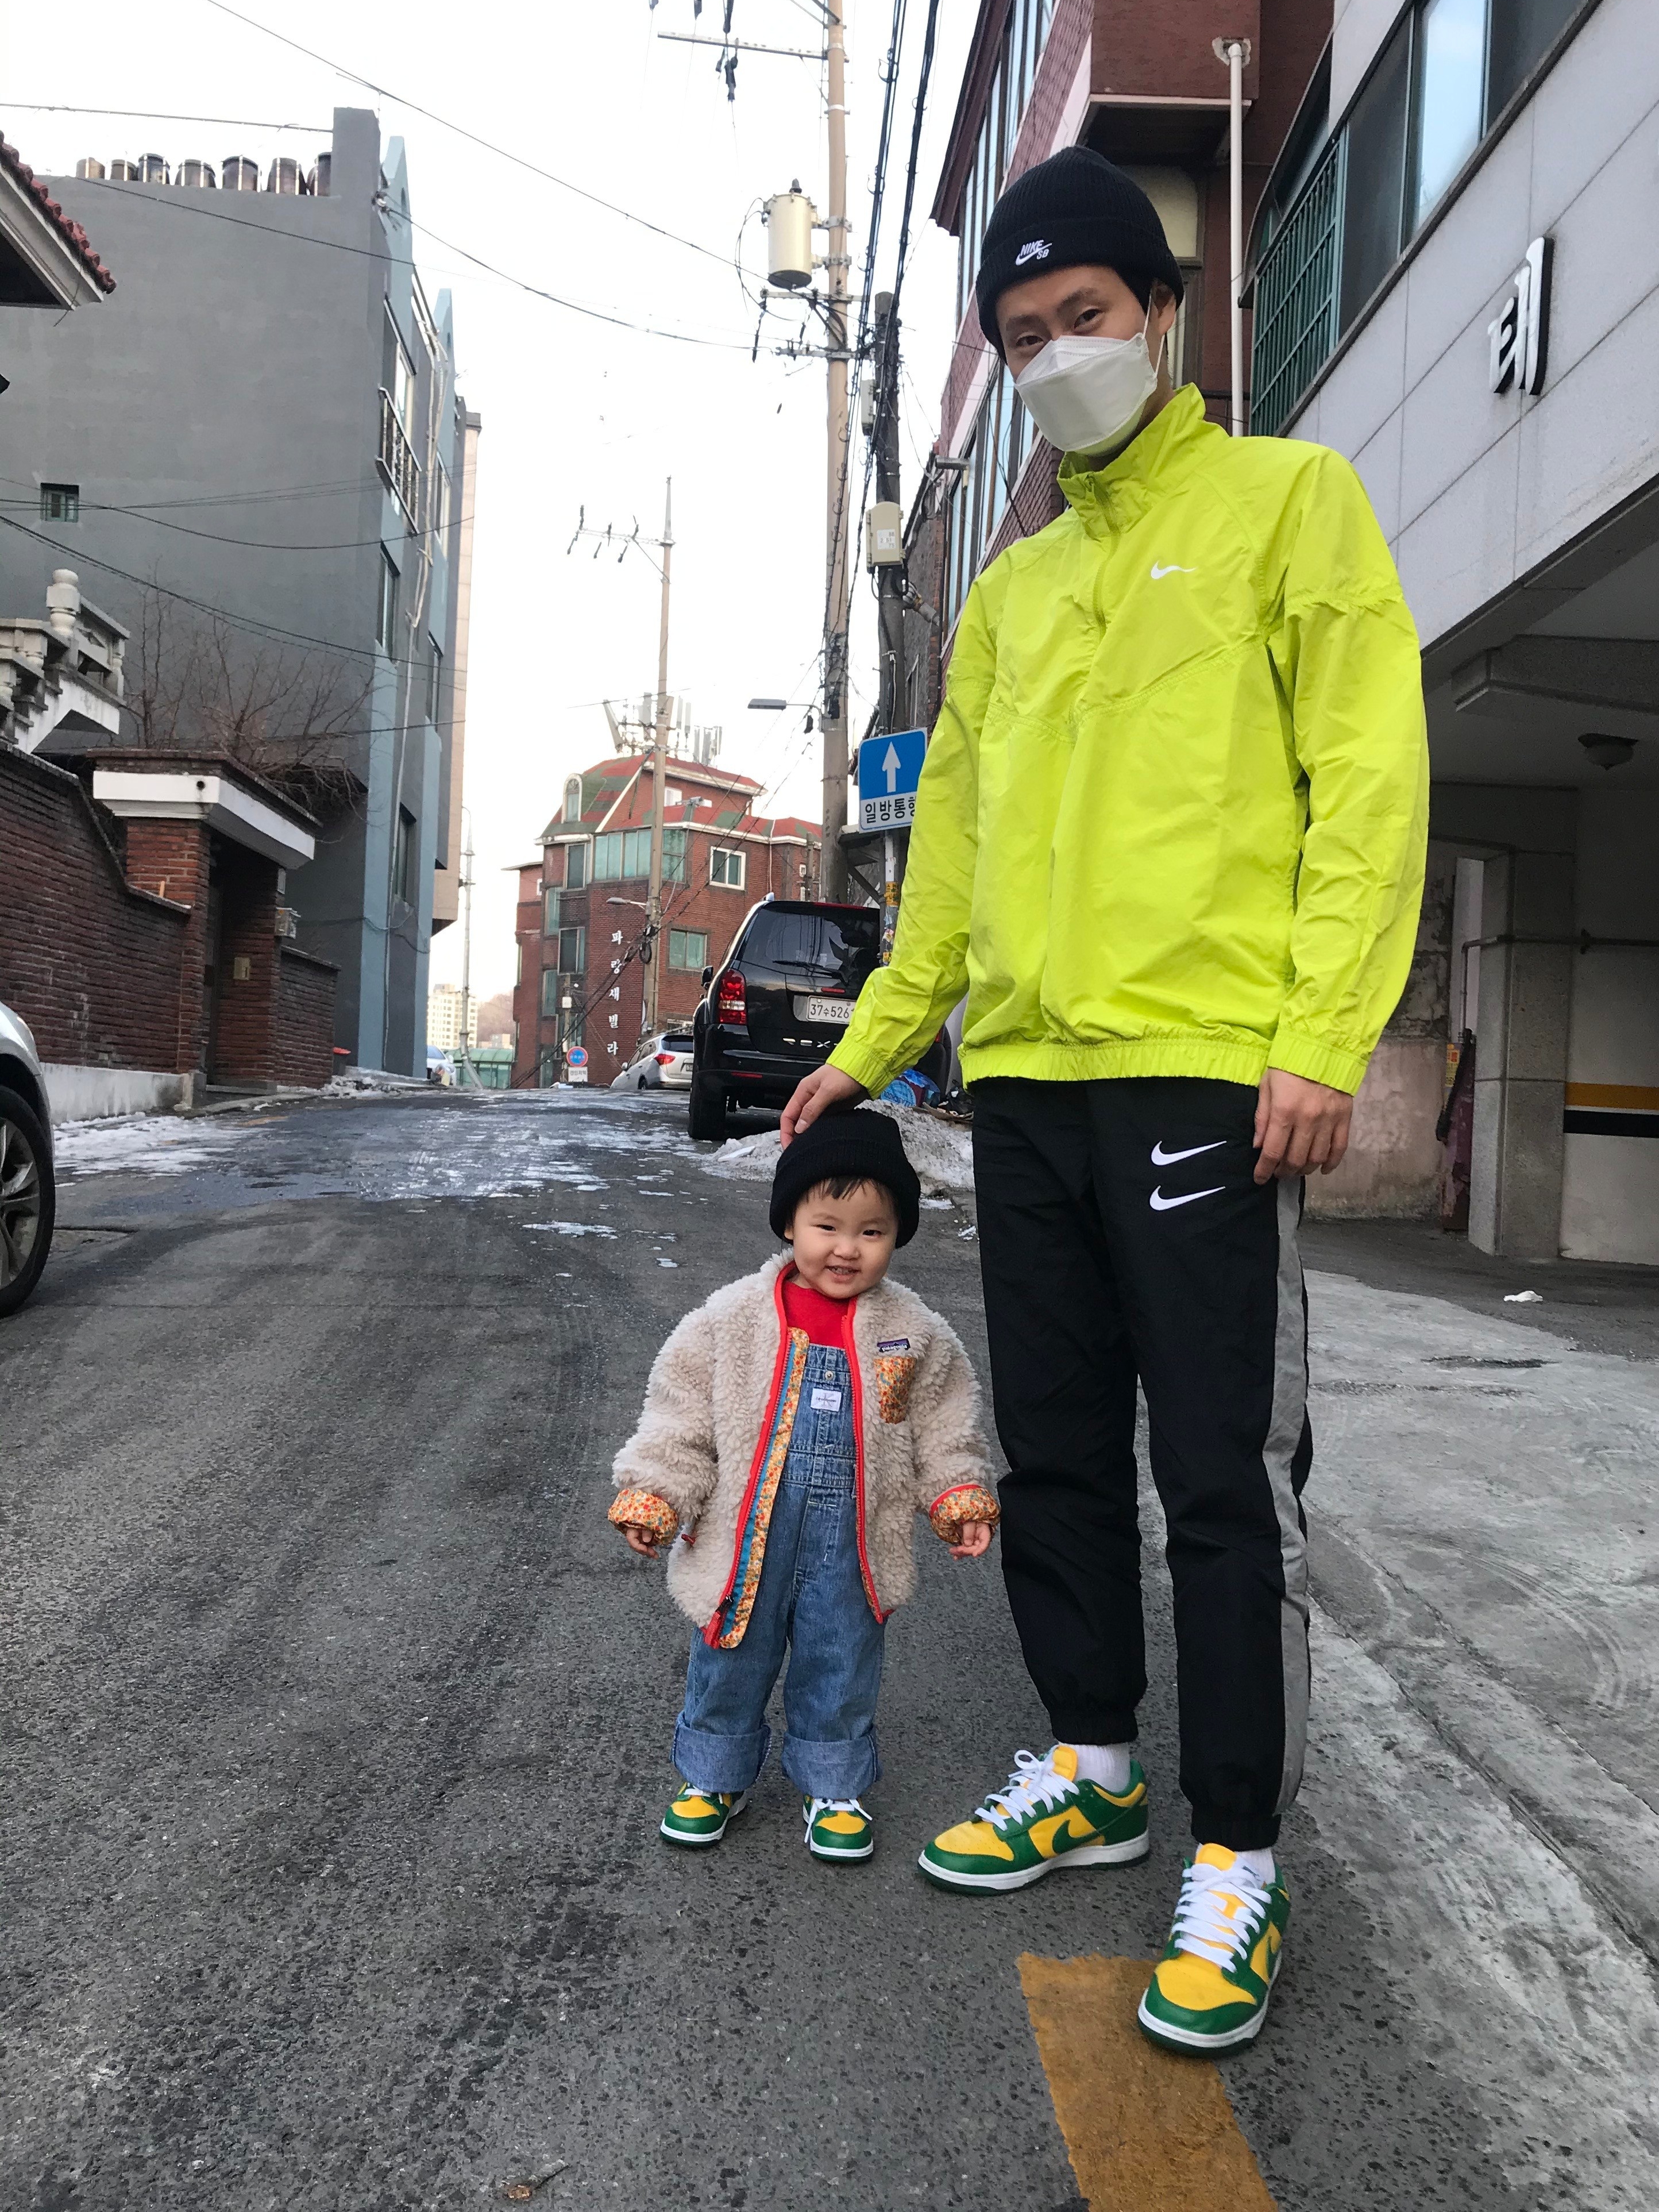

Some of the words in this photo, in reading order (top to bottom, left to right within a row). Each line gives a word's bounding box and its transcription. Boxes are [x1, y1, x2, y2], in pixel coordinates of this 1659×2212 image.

[1020, 240, 1044, 256] NIKE
[1036, 249, 1050, 260] SB
[811, 1004, 855, 1019] 37수526
[783, 1038, 838, 1048] REX
